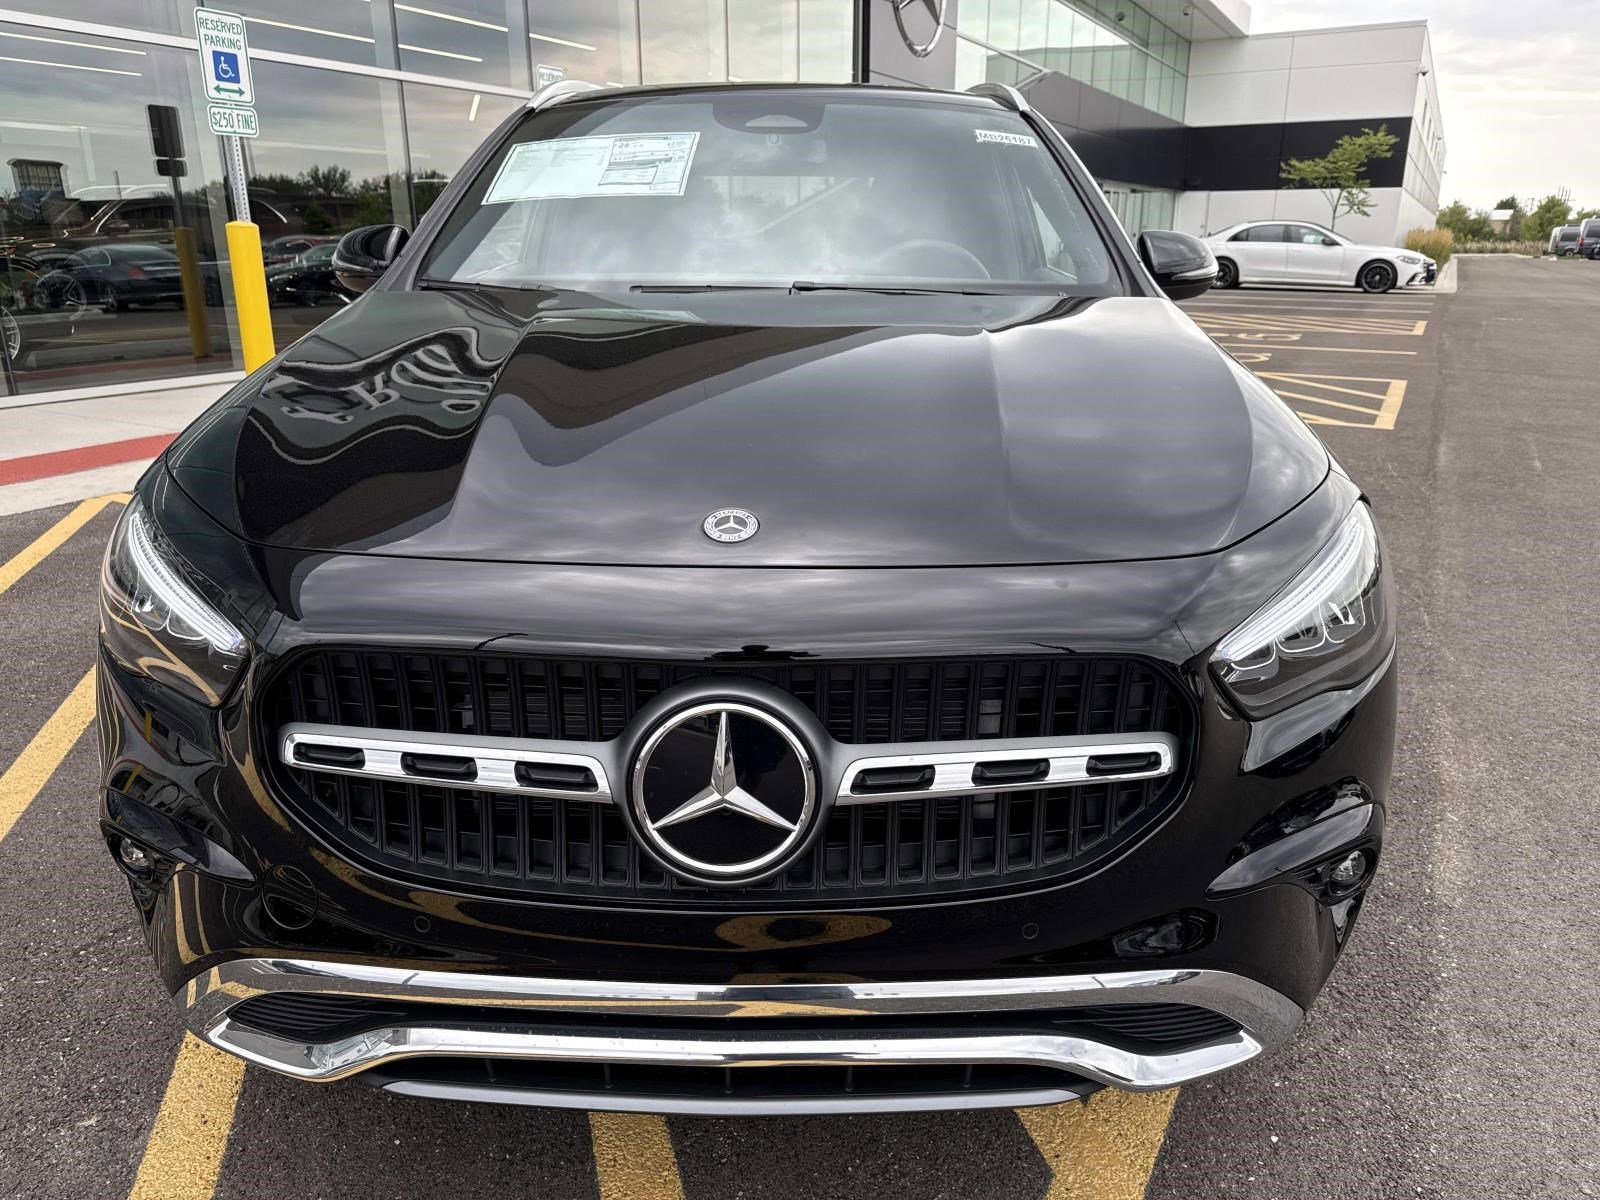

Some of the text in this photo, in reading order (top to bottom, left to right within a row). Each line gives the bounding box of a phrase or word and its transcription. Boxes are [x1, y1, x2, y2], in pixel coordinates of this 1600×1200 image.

[199, 18, 242, 35] RESERVED
[204, 34, 242, 50] PARKING
[211, 111, 255, 131] $250 FINE
